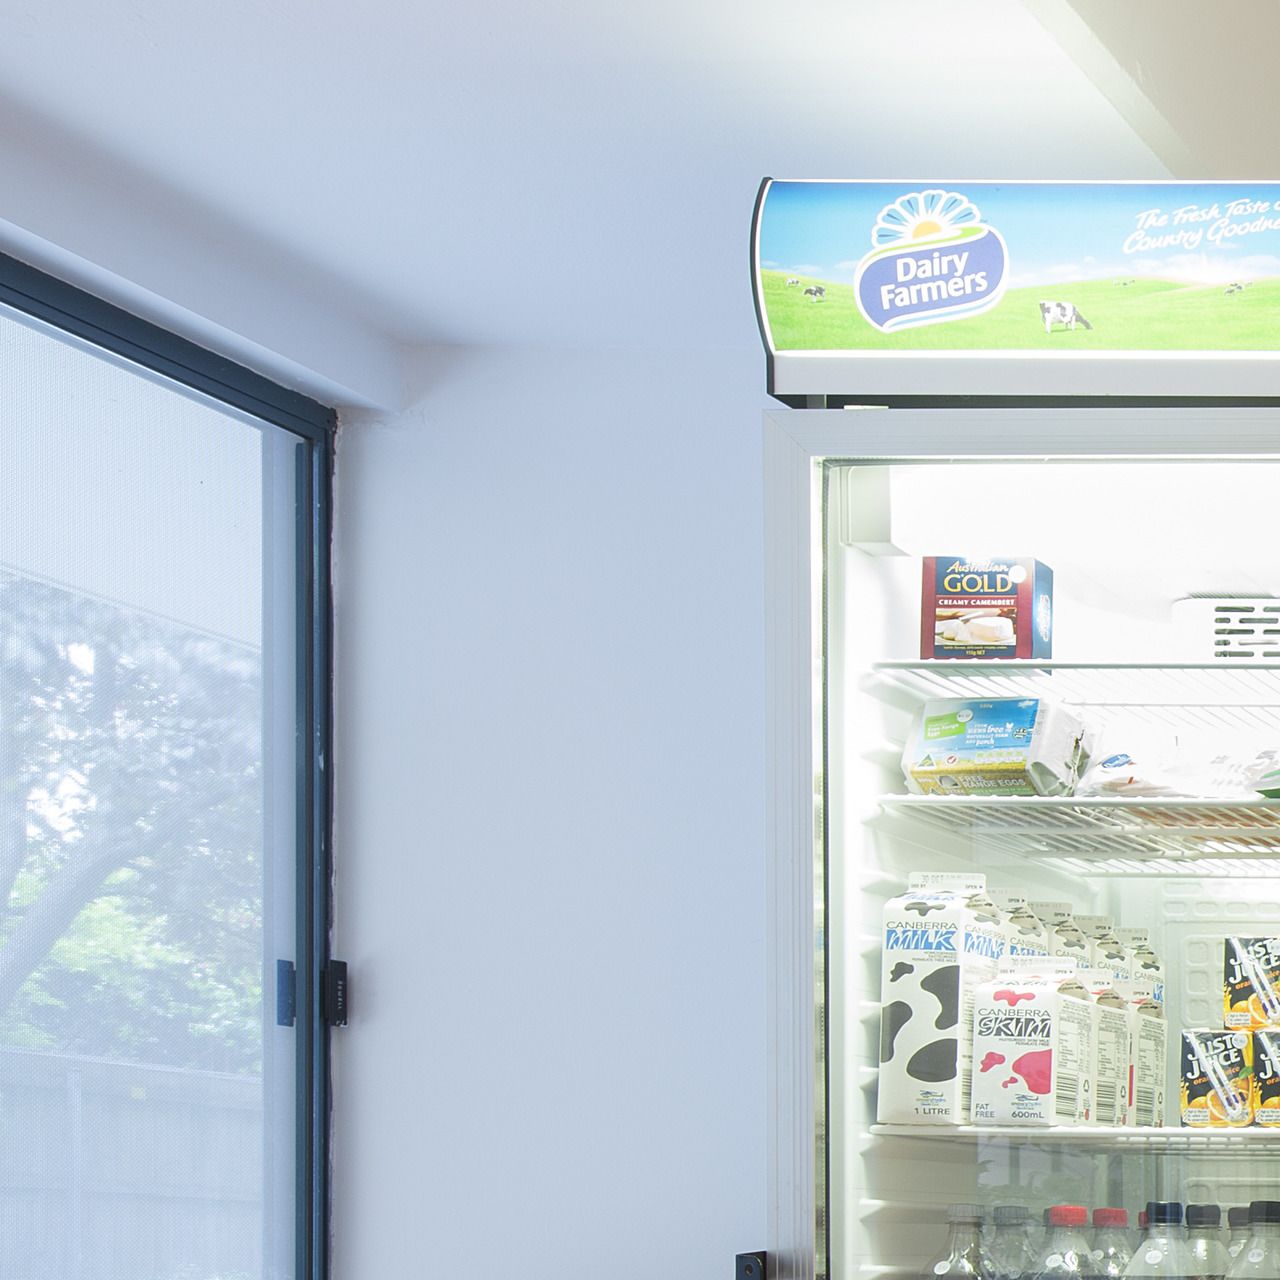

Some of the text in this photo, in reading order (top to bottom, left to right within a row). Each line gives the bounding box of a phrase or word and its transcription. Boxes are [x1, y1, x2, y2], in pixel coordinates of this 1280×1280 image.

[1135, 208, 1169, 230] The
[1173, 202, 1224, 227] Fresh
[1227, 197, 1271, 222] Taste
[1123, 225, 1206, 255] Country
[895, 249, 968, 281] Dairy
[880, 273, 989, 311] Farmers
[943, 574, 1013, 593] GOLD
[938, 598, 1016, 606] CREAMY CAMEMBERT
[886, 922, 958, 930] CANBERRA
[886, 930, 956, 951] MILK
[978, 1009, 1051, 1017] CANBERRA
[914, 1107, 950, 1115] 1 LITRE
[1011, 1111, 1044, 1119] 600mL
